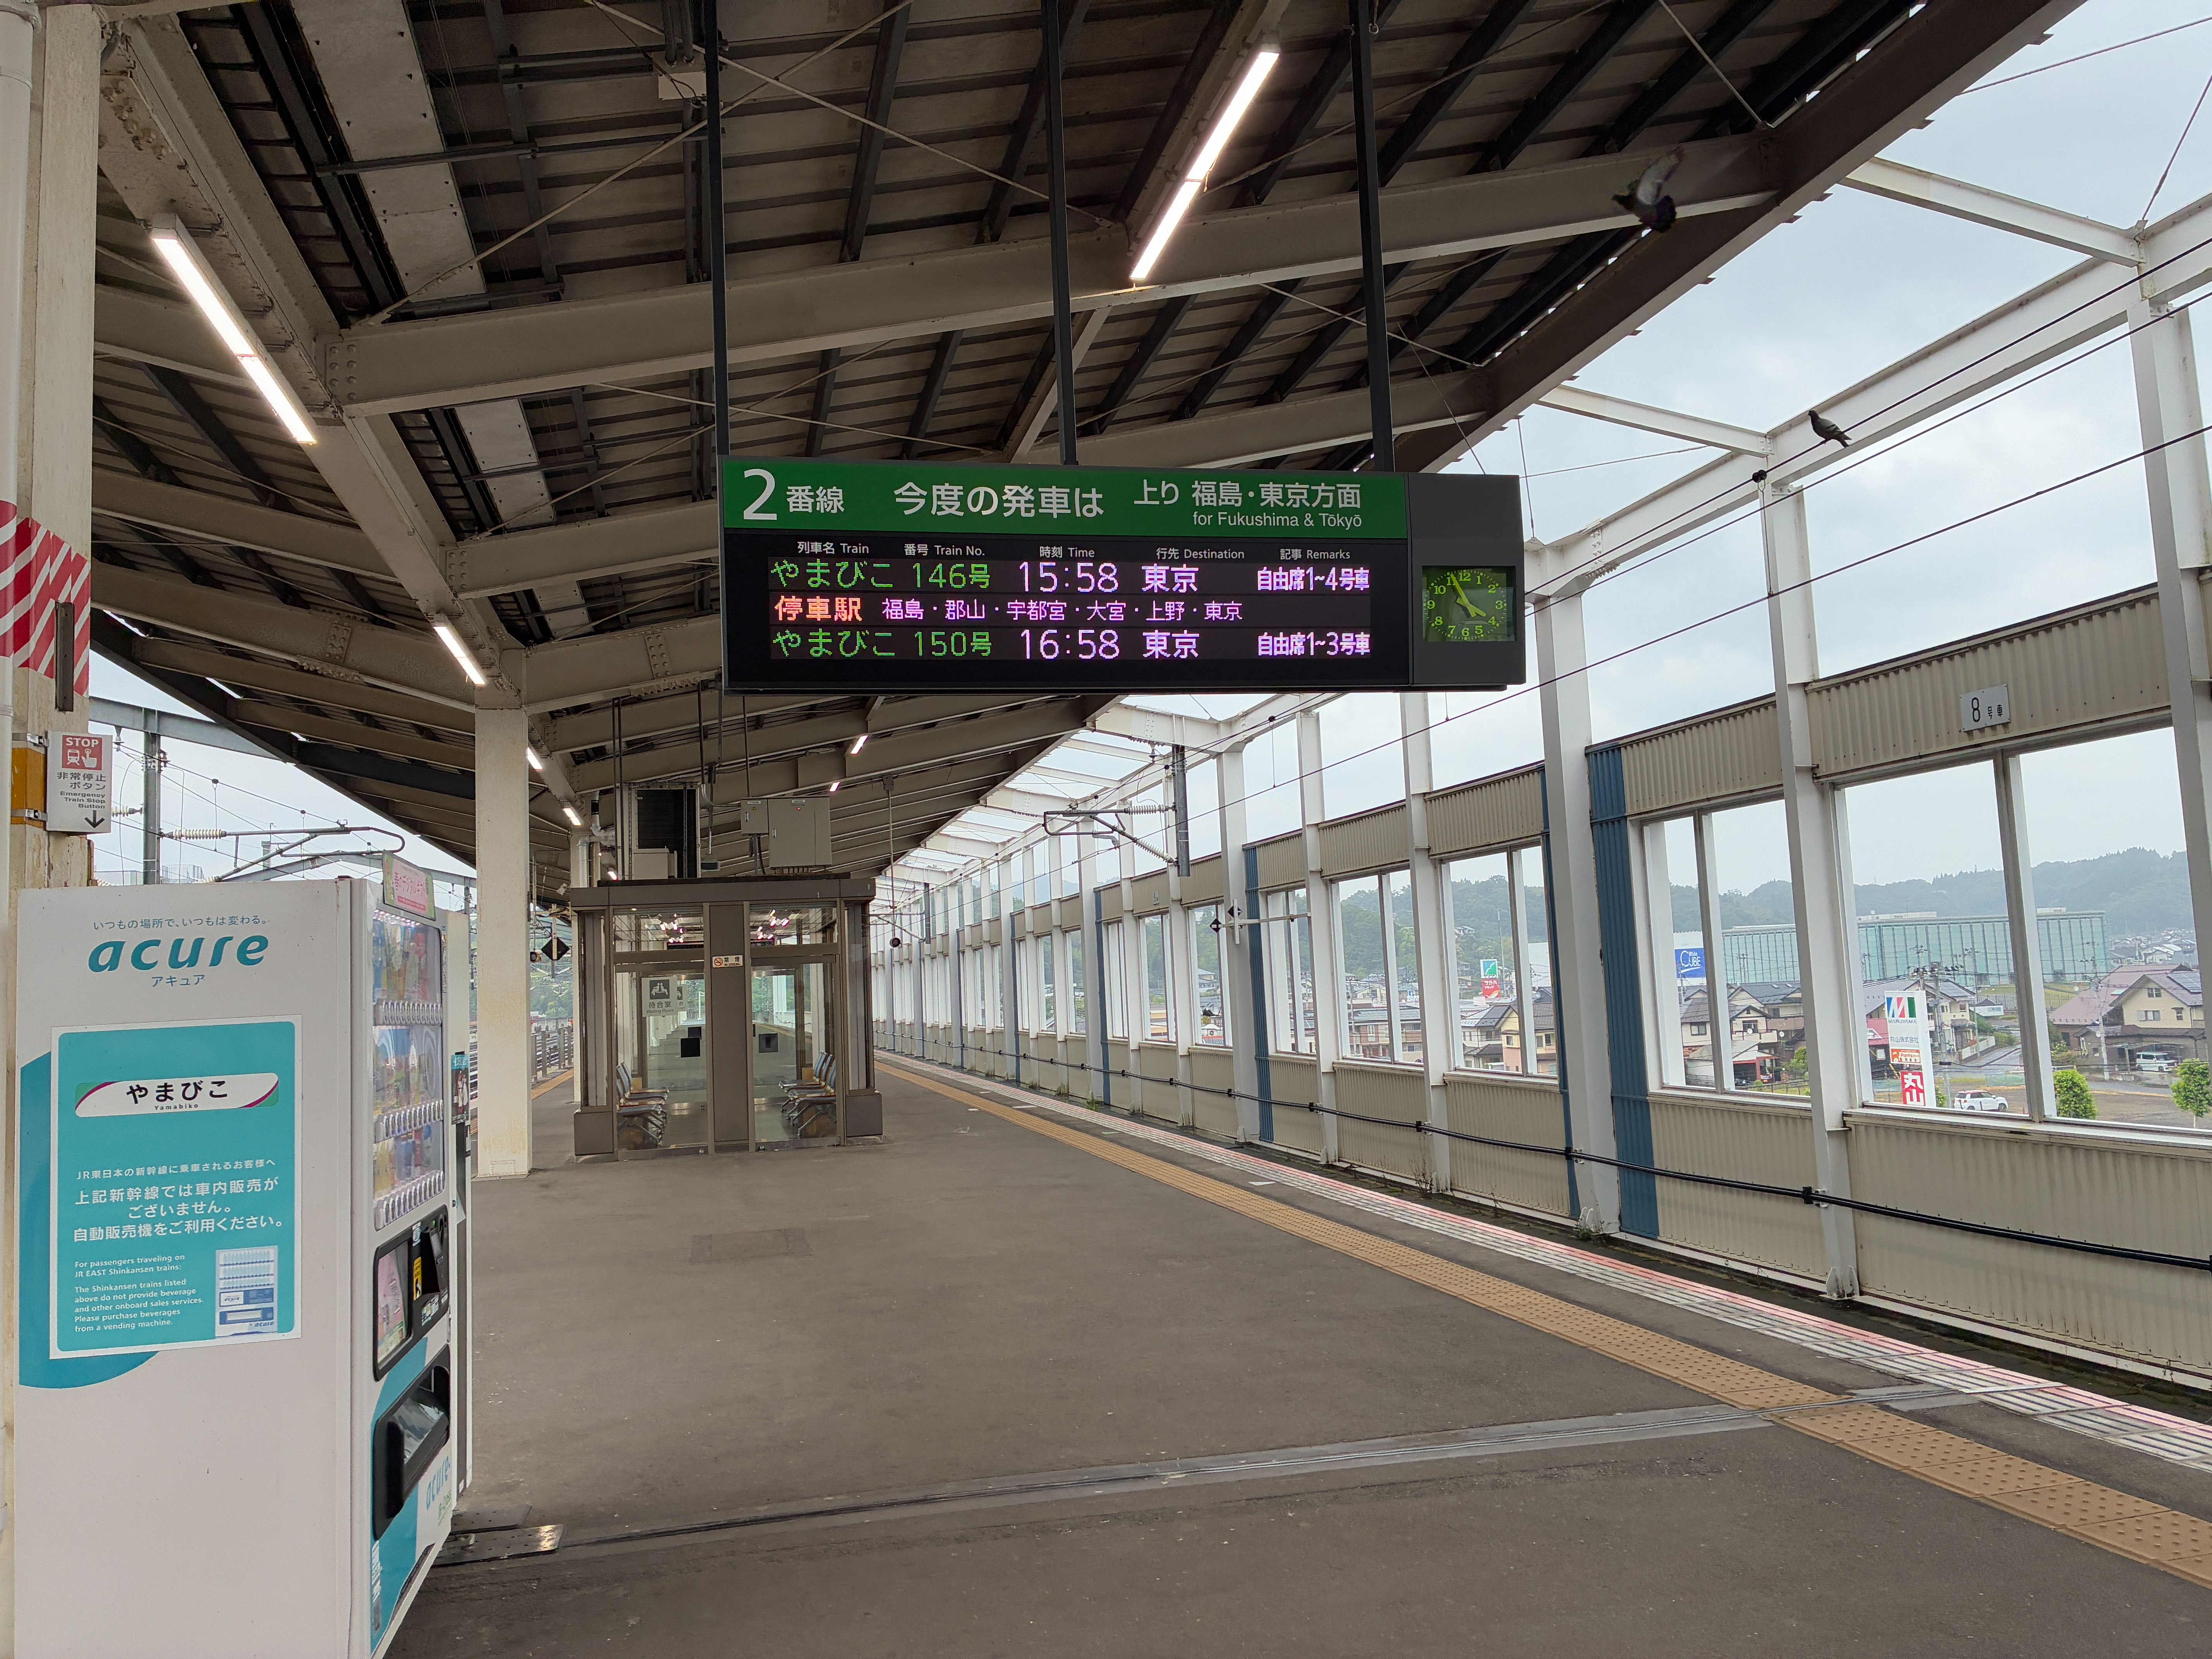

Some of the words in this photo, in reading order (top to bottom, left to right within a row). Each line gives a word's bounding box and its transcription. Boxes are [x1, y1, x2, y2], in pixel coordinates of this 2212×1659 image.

[1133, 480, 1179, 505] 上り
[1192, 480, 1361, 509] 福島・東京方面
[893, 481, 1104, 519] 今度の発車は
[1193, 512, 1213, 526] for
[1218, 512, 1299, 527] Fukushima
[1304, 514, 1314, 527] &
[1319, 514, 1362, 531] Tōkyō
[797, 542, 835, 555] 列車名
[840, 543, 869, 555] Train
[904, 543, 929, 556] 番号
[934, 545, 962, 556] Train
[966, 545, 985, 556] No.
[1039, 546, 1063, 558] 時刻
[1068, 546, 1095, 558] Time
[1156, 548, 1179, 560] 行先
[1184, 548, 1245, 560] Destination
[1280, 548, 1302, 561] 記事
[1306, 549, 1350, 560] Remarks
[770, 558, 893, 588] やまびこ
[912, 562, 991, 589] 146号
[1019, 561, 1120, 593] 15:58
[1141, 563, 1200, 594] 東京
[1459, 572, 1471, 581] 12
[1477, 575, 1482, 584] 1
[1434, 585, 1446, 594] 10
[1488, 584, 1496, 593] 2
[775, 595, 863, 622] 停車駅
[1427, 600, 1436, 609] 9
[1495, 600, 1503, 609] 3
[1434, 616, 1443, 625] 8
[1488, 616, 1497, 625] 4
[1448, 625, 1456, 634] 7
[1462, 627, 1470, 637] 6
[1475, 625, 1483, 634] 5
[773, 629, 895, 657] やまびこ
[914, 631, 992, 657] 150号
[1020, 629, 1120, 660] 16:58
[1142, 630, 1200, 659] 東京
[66, 737, 99, 747] STOP
[57, 772, 106, 782] 非常停止
[70, 781, 106, 790] ボタン
[93, 915, 269, 930] いつもの場所で、いつもは変わる。
[88, 935, 269, 973] acure
[151, 974, 205, 987] アキュア
[126, 1080, 228, 1104] やまびこ
[1903, 1072, 1924, 1106] 丸山
[75, 1176, 278, 1205] 上記新幹線では車内販売が
[128, 1200, 231, 1219] ございません。
[74, 1215, 282, 1242] 自動販売機をご利用ください。
[90, 1258, 135, 1268] passengers
[137, 1255, 172, 1264] traveling
[109, 1266, 154, 1275] Shinkansen
[92, 1283, 137, 1292] Shinkansen
[129, 1291, 158, 1300] provide
[115, 1302, 148, 1310] onboard
[102, 1312, 138, 1322] purchase
[140, 1309, 181, 1317] beverages
